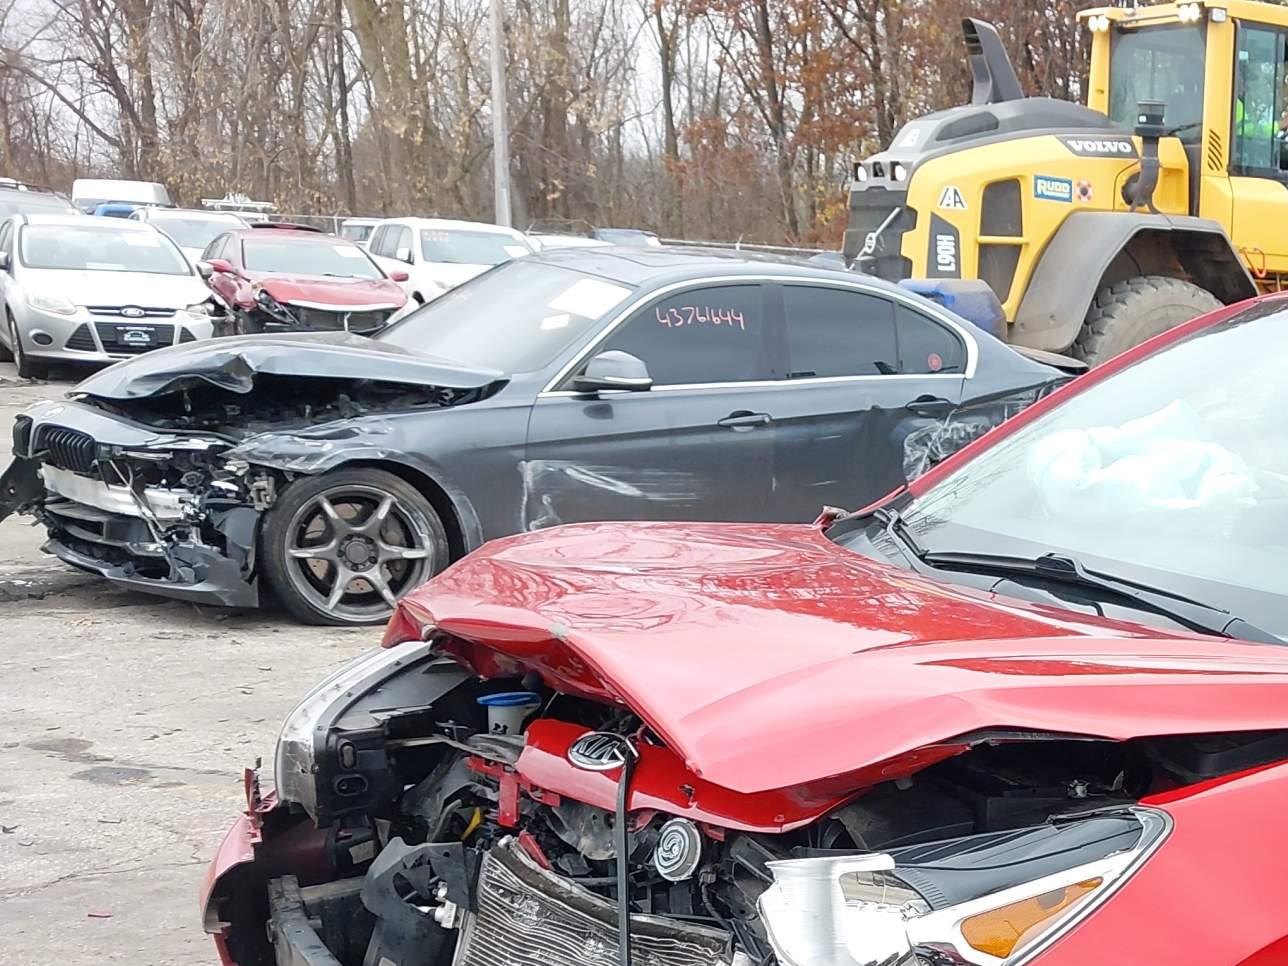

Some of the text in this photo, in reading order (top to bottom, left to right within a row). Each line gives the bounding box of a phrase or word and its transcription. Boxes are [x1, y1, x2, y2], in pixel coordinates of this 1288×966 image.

[1066, 140, 1132, 152] VOLVO
[1036, 179, 1070, 197] RUDD
[655, 305, 745, 330] 43761644
[572, 734, 626, 764] KIA
